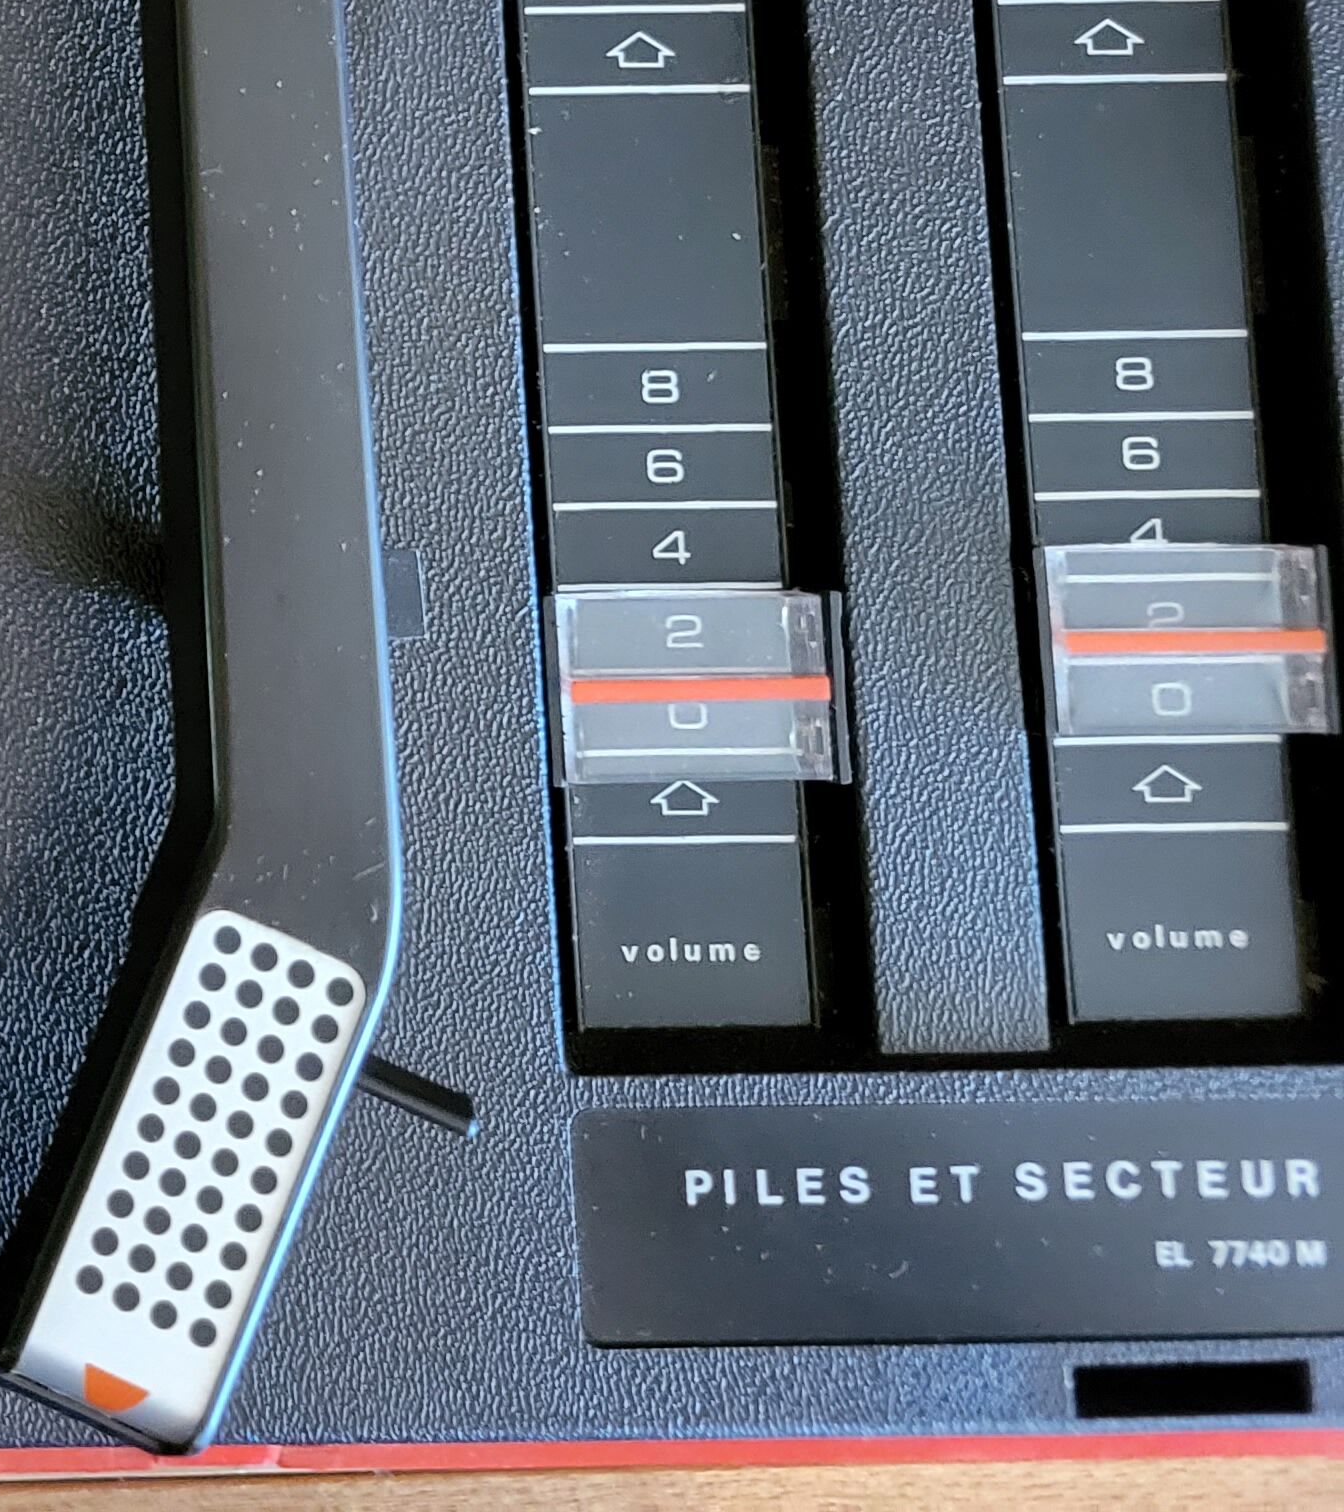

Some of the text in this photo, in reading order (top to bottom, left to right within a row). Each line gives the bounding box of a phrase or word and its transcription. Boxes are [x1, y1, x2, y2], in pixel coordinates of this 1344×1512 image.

[641, 369, 680, 404] 8
[1115, 356, 1154, 391] 8
[646, 448, 685, 484] 6
[1122, 436, 1161, 471] 6
[652, 530, 692, 565] 4
[1129, 517, 1169, 544] 4
[664, 614, 704, 648] 2
[1146, 601, 1185, 628] 2
[1151, 681, 1193, 717] 0
[621, 937, 761, 963] volume
[1106, 923, 1249, 951] volume
[684, 1158, 1320, 1206] PILES ET SECTEUR
[1155, 1239, 1327, 1268] EL 7740 M
